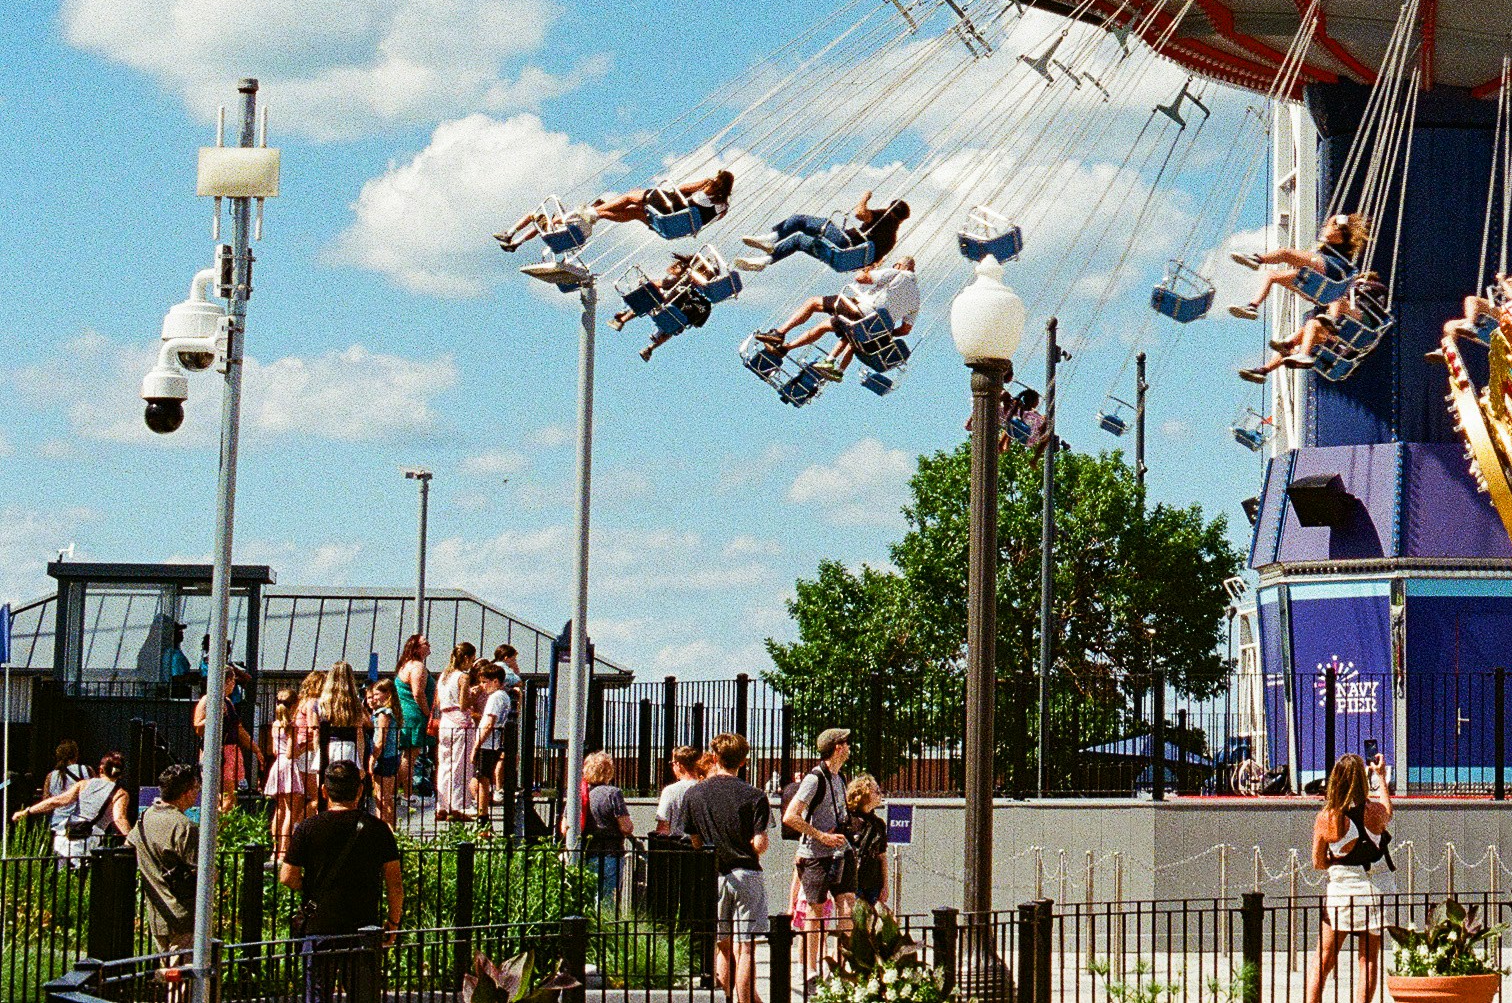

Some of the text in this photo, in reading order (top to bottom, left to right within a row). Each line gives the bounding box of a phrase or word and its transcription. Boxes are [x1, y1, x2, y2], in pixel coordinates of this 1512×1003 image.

[1335, 681, 1379, 697] NAVY
[1336, 698, 1378, 713] PIER
[890, 819, 910, 828] EXIT
